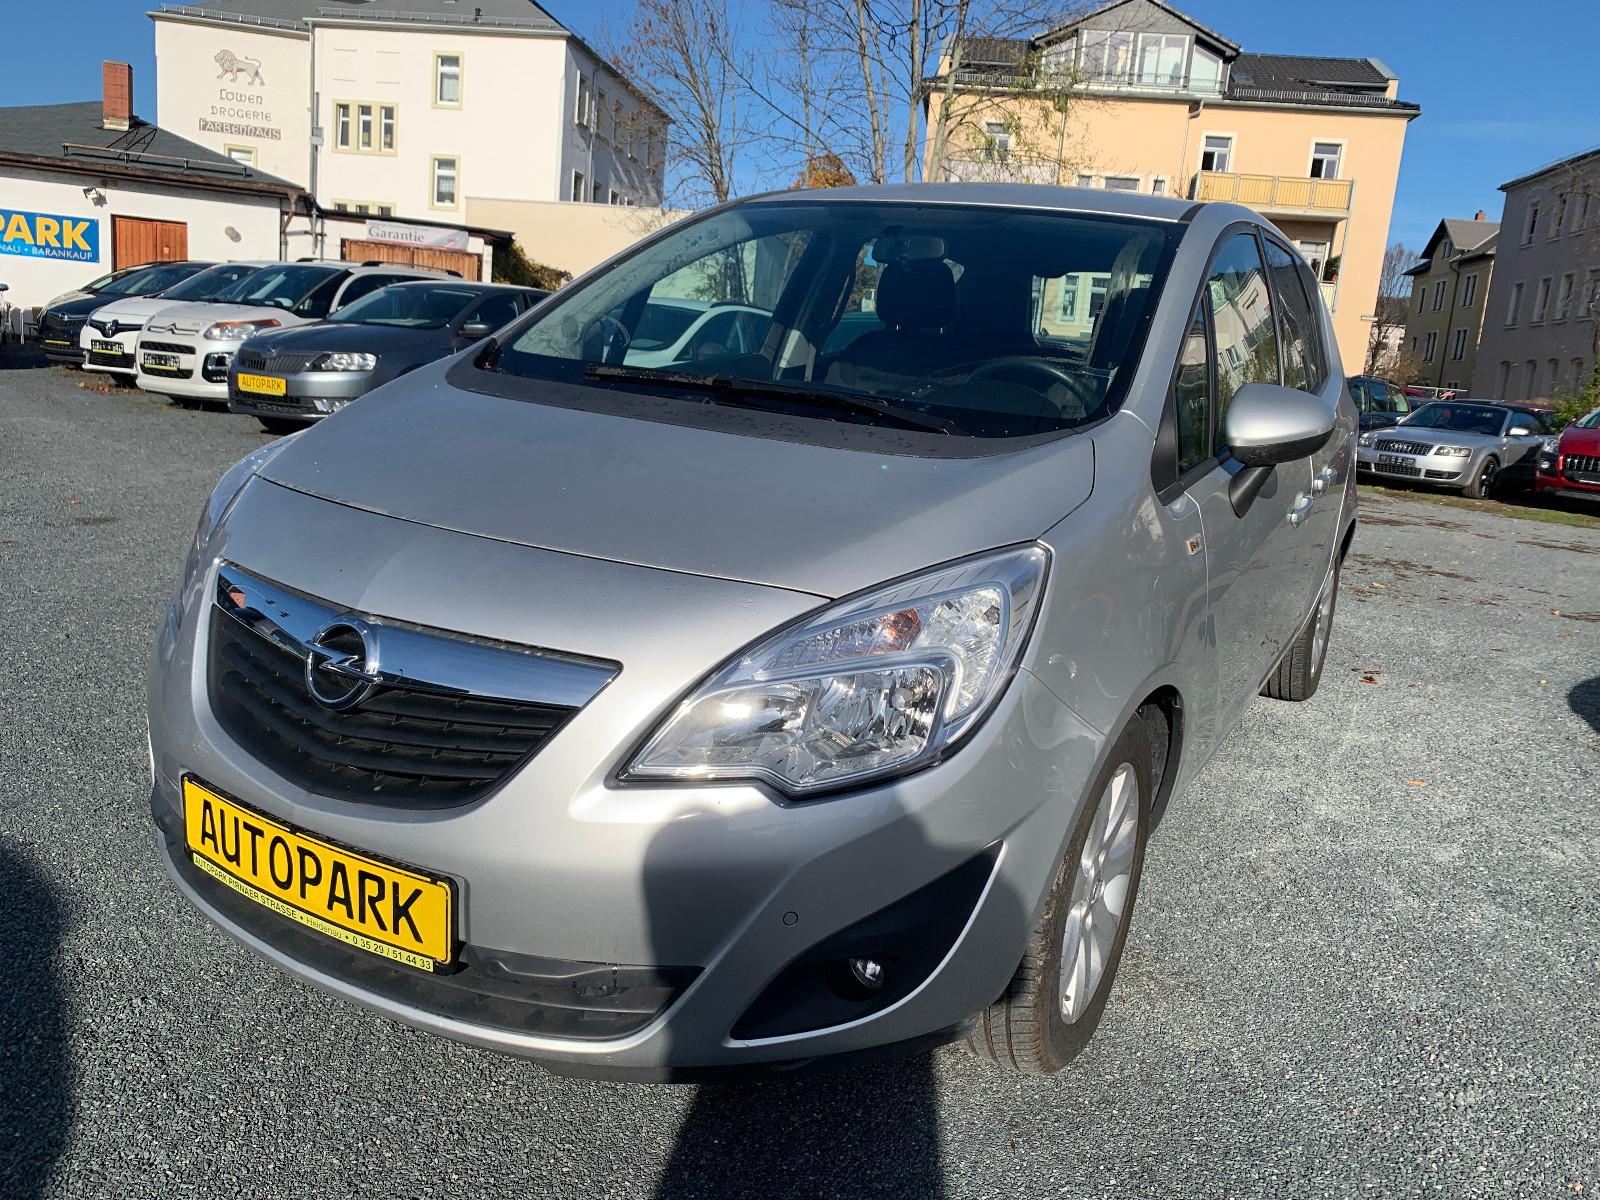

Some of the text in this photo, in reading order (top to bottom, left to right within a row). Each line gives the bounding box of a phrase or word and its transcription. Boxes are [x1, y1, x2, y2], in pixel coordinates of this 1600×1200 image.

[0, 213, 92, 251] ARK
[368, 226, 425, 243] Garantie
[32, 246, 93, 260] BARANKAUF
[241, 376, 282, 391] AUTOPARK
[200, 798, 424, 945] AUTOPARK
[194, 855, 228, 883] AUTOPARK
[228, 878, 260, 902] PIRNAER
[260, 896, 298, 920] STRASSE
[306, 916, 342, 939] Heidenau
[352, 935, 358, 945] 0
[360, 938, 371, 950] 35
[373, 943, 384, 954] 29
[392, 950, 403, 961] 51
[405, 954, 417, 966] 44
[419, 958, 431, 970] 33
